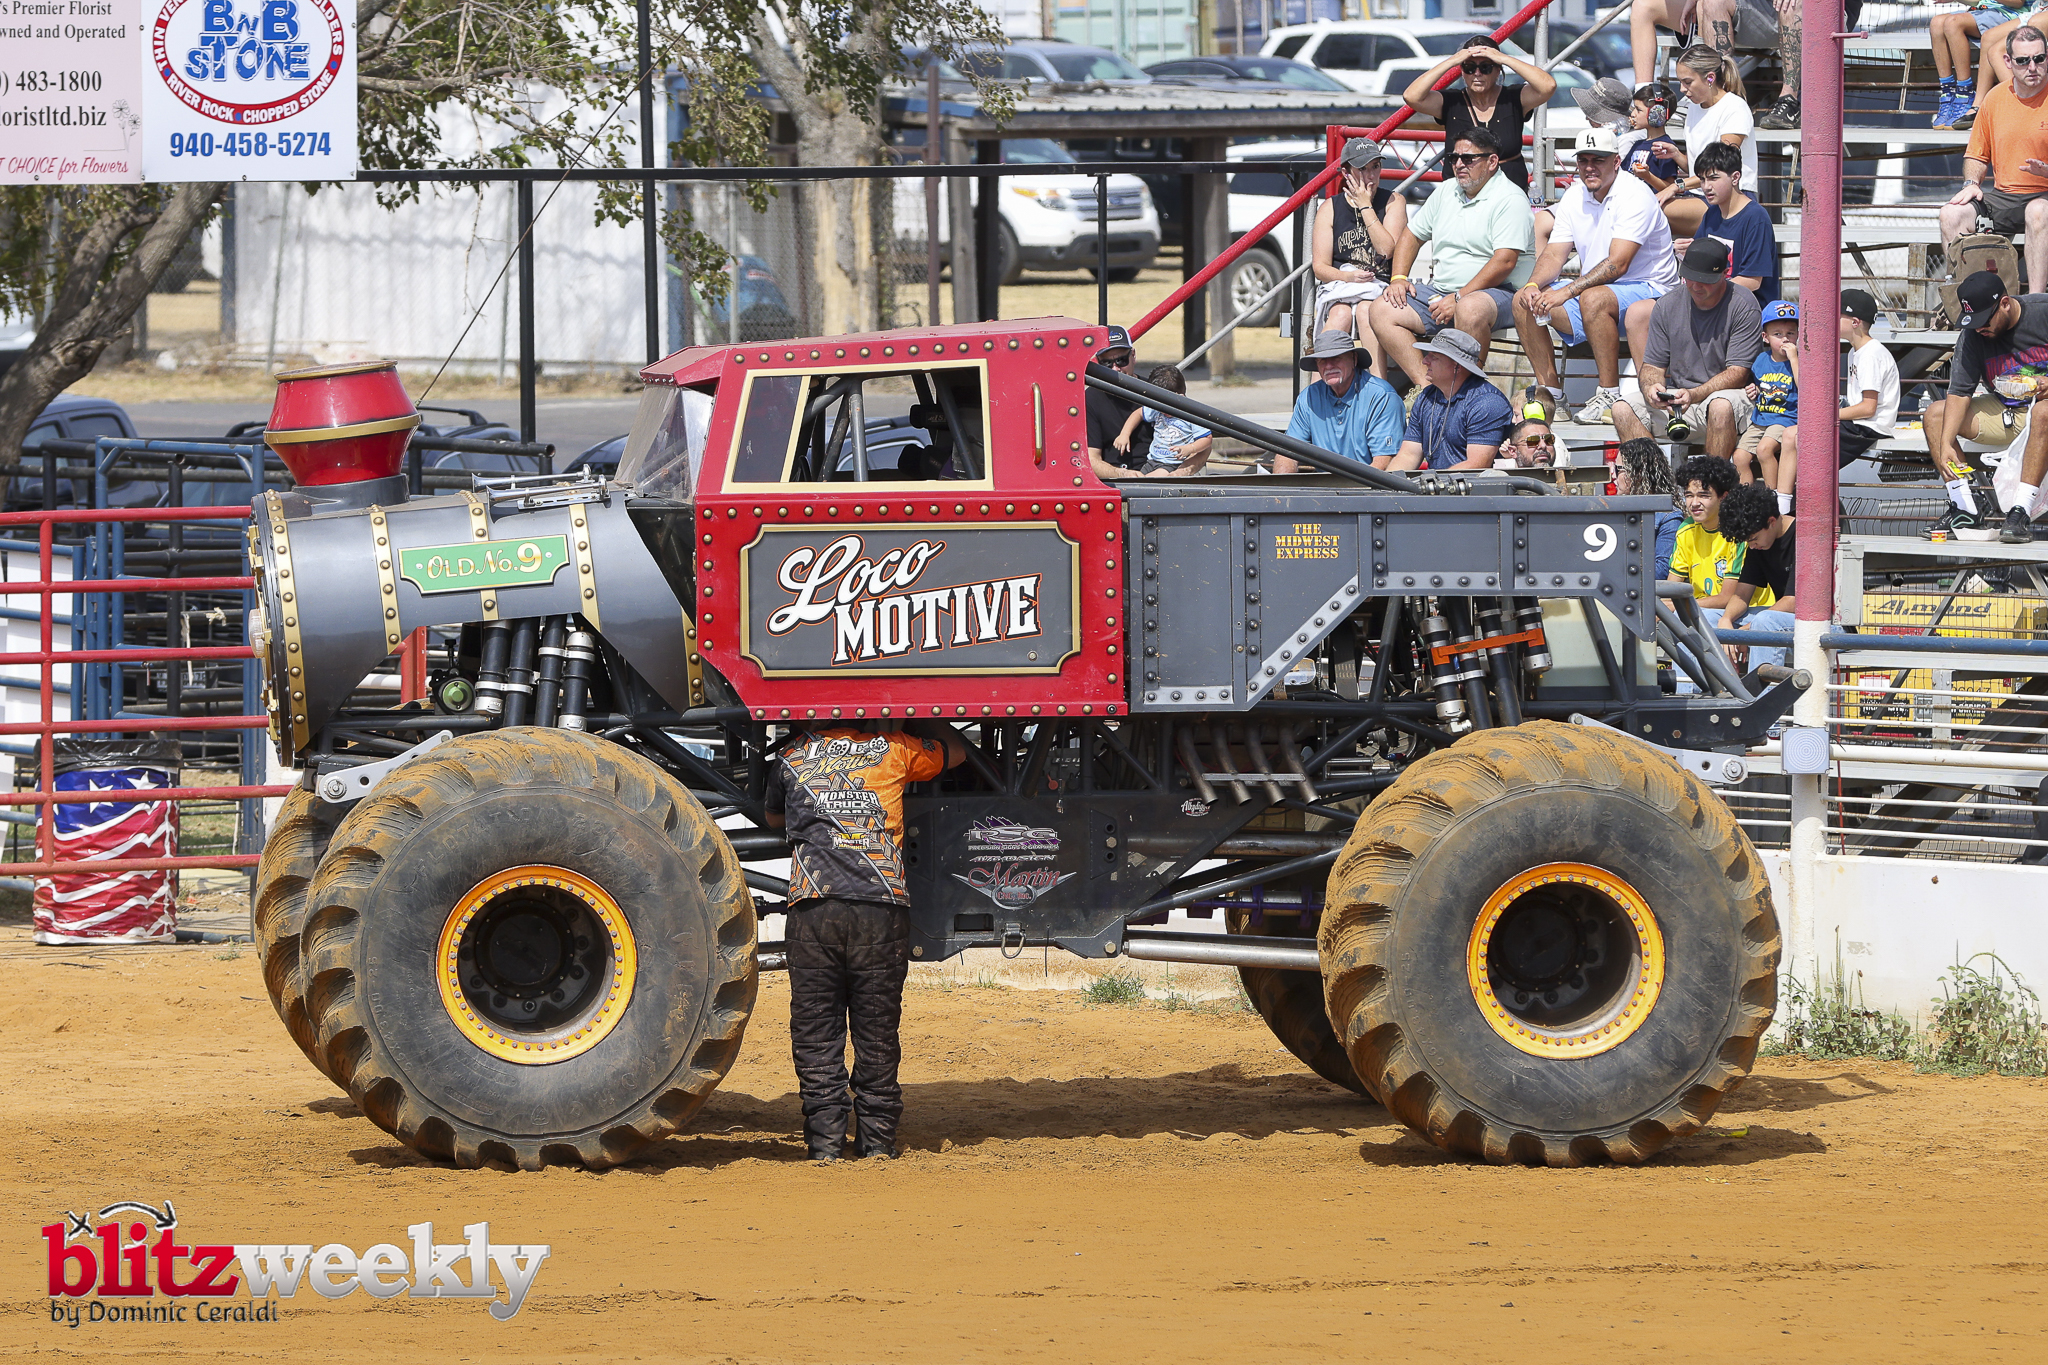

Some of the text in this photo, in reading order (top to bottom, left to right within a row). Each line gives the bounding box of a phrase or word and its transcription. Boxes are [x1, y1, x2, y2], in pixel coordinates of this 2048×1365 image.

[12, 1, 65, 15] Premier
[69, 0, 112, 15] Florist
[36, 24, 60, 38] and
[64, 24, 126, 42] Operated
[153, 26, 167, 71] THIN
[184, 32, 310, 81] STONE
[15, 70, 102, 92] 483-1800
[167, 69, 333, 124] RIVER ROCK CHOPPED STONE
[170, 132, 331, 157] 940-458-5274
[8, 157, 58, 174] CHOICE
[57, 157, 78, 180] for
[80, 157, 129, 174] Flowers
[1292, 523, 1322, 535] THE
[1274, 535, 1340, 547] MIDWEST
[1582, 523, 1617, 562] 9
[427, 555, 476, 580] OLD
[517, 542, 543, 573] 9
[1275, 547, 1340, 559] EXPRESS
[767, 534, 946, 637] Loco
[831, 573, 1042, 666] MOTIVE
[816, 790, 879, 806] MONSTER
[824, 800, 870, 809] TRUCK
[833, 837, 870, 847] MONSTER
[967, 862, 1061, 888] Martin
